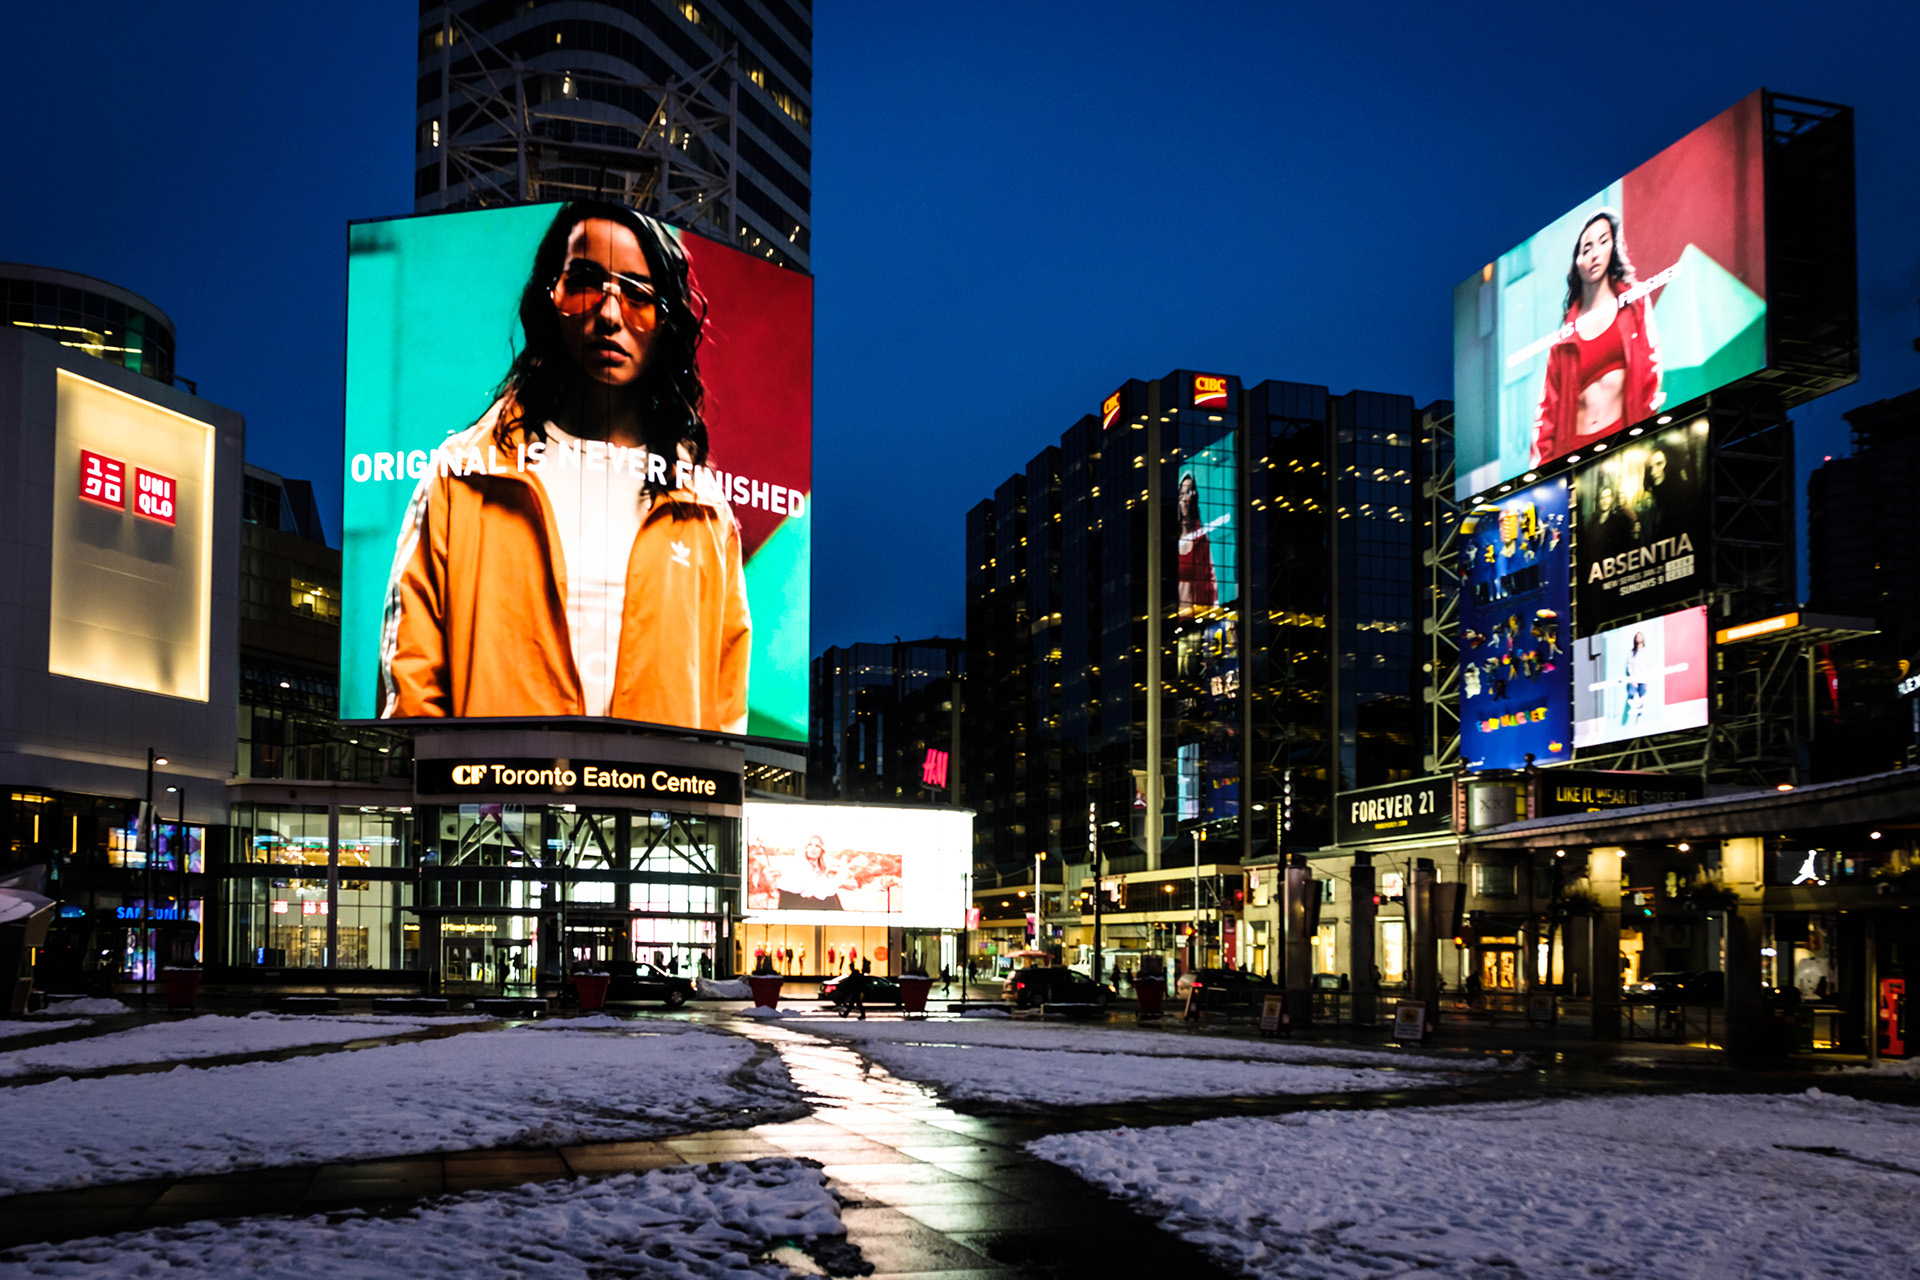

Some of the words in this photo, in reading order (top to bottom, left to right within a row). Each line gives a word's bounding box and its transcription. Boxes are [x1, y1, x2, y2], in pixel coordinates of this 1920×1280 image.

[1195, 376, 1226, 393] CIBC
[86, 457, 121, 483] ユニ
[351, 445, 507, 483] ORIGINAL
[517, 442, 547, 473] IS
[558, 439, 668, 486] NEVER
[675, 459, 805, 518] FINISHED
[139, 473, 171, 499] UNI
[138, 493, 173, 518] QLO
[1587, 532, 1694, 585] ABSENTIA
[1619, 577, 1657, 596] SUNDAYS
[452, 765, 487, 786] CF
[491, 764, 577, 787] Toronto
[583, 766, 646, 790] Eaton
[651, 770, 717, 796] Centre
[1351, 794, 1413, 824] FOREVER
[1418, 790, 1435, 815] 21
[1556, 785, 1581, 803] LIKE
